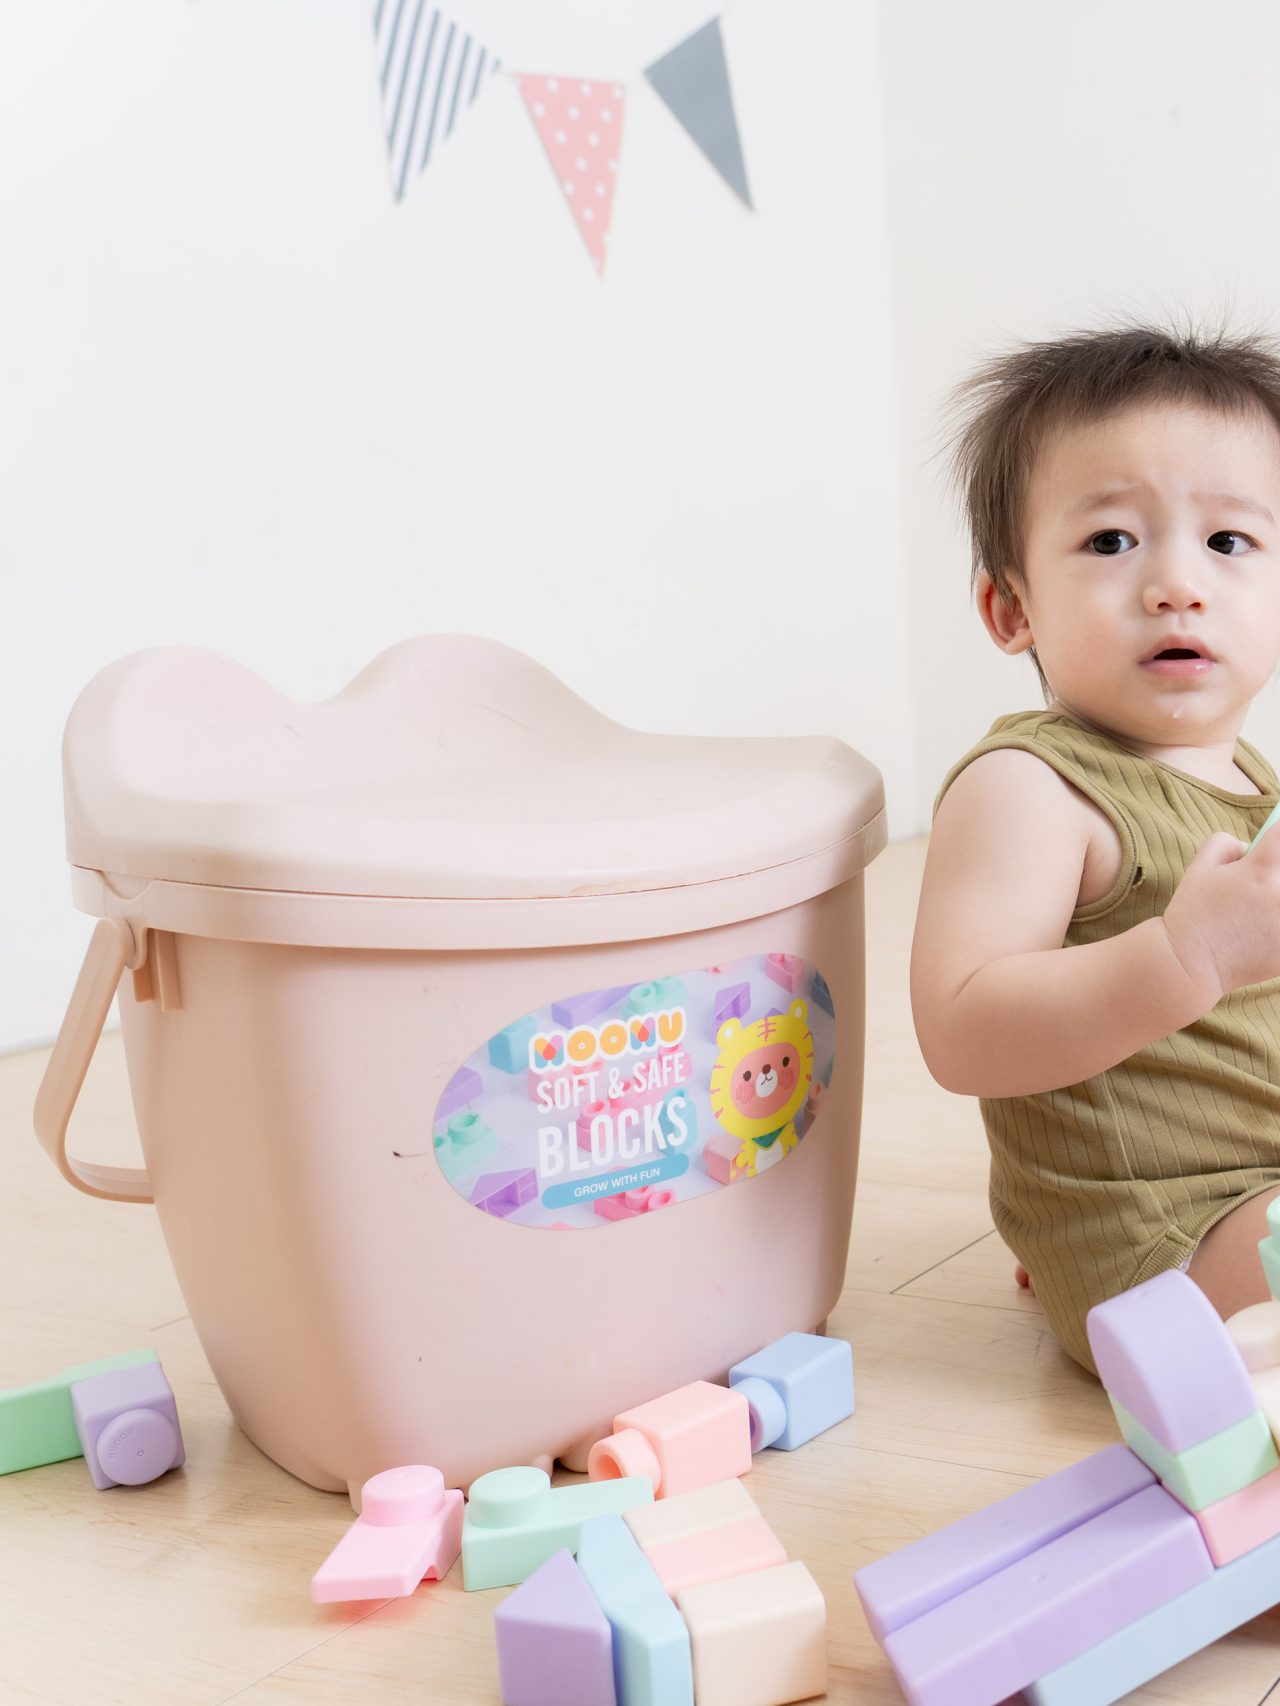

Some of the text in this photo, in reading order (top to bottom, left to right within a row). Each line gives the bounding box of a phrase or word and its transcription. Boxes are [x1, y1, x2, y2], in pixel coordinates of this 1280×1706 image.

[536, 1051, 686, 1114] SOFT & SAFE
[537, 1095, 688, 1179] BLOCKS
[573, 1167, 661, 1198] GROW WITH FUN
